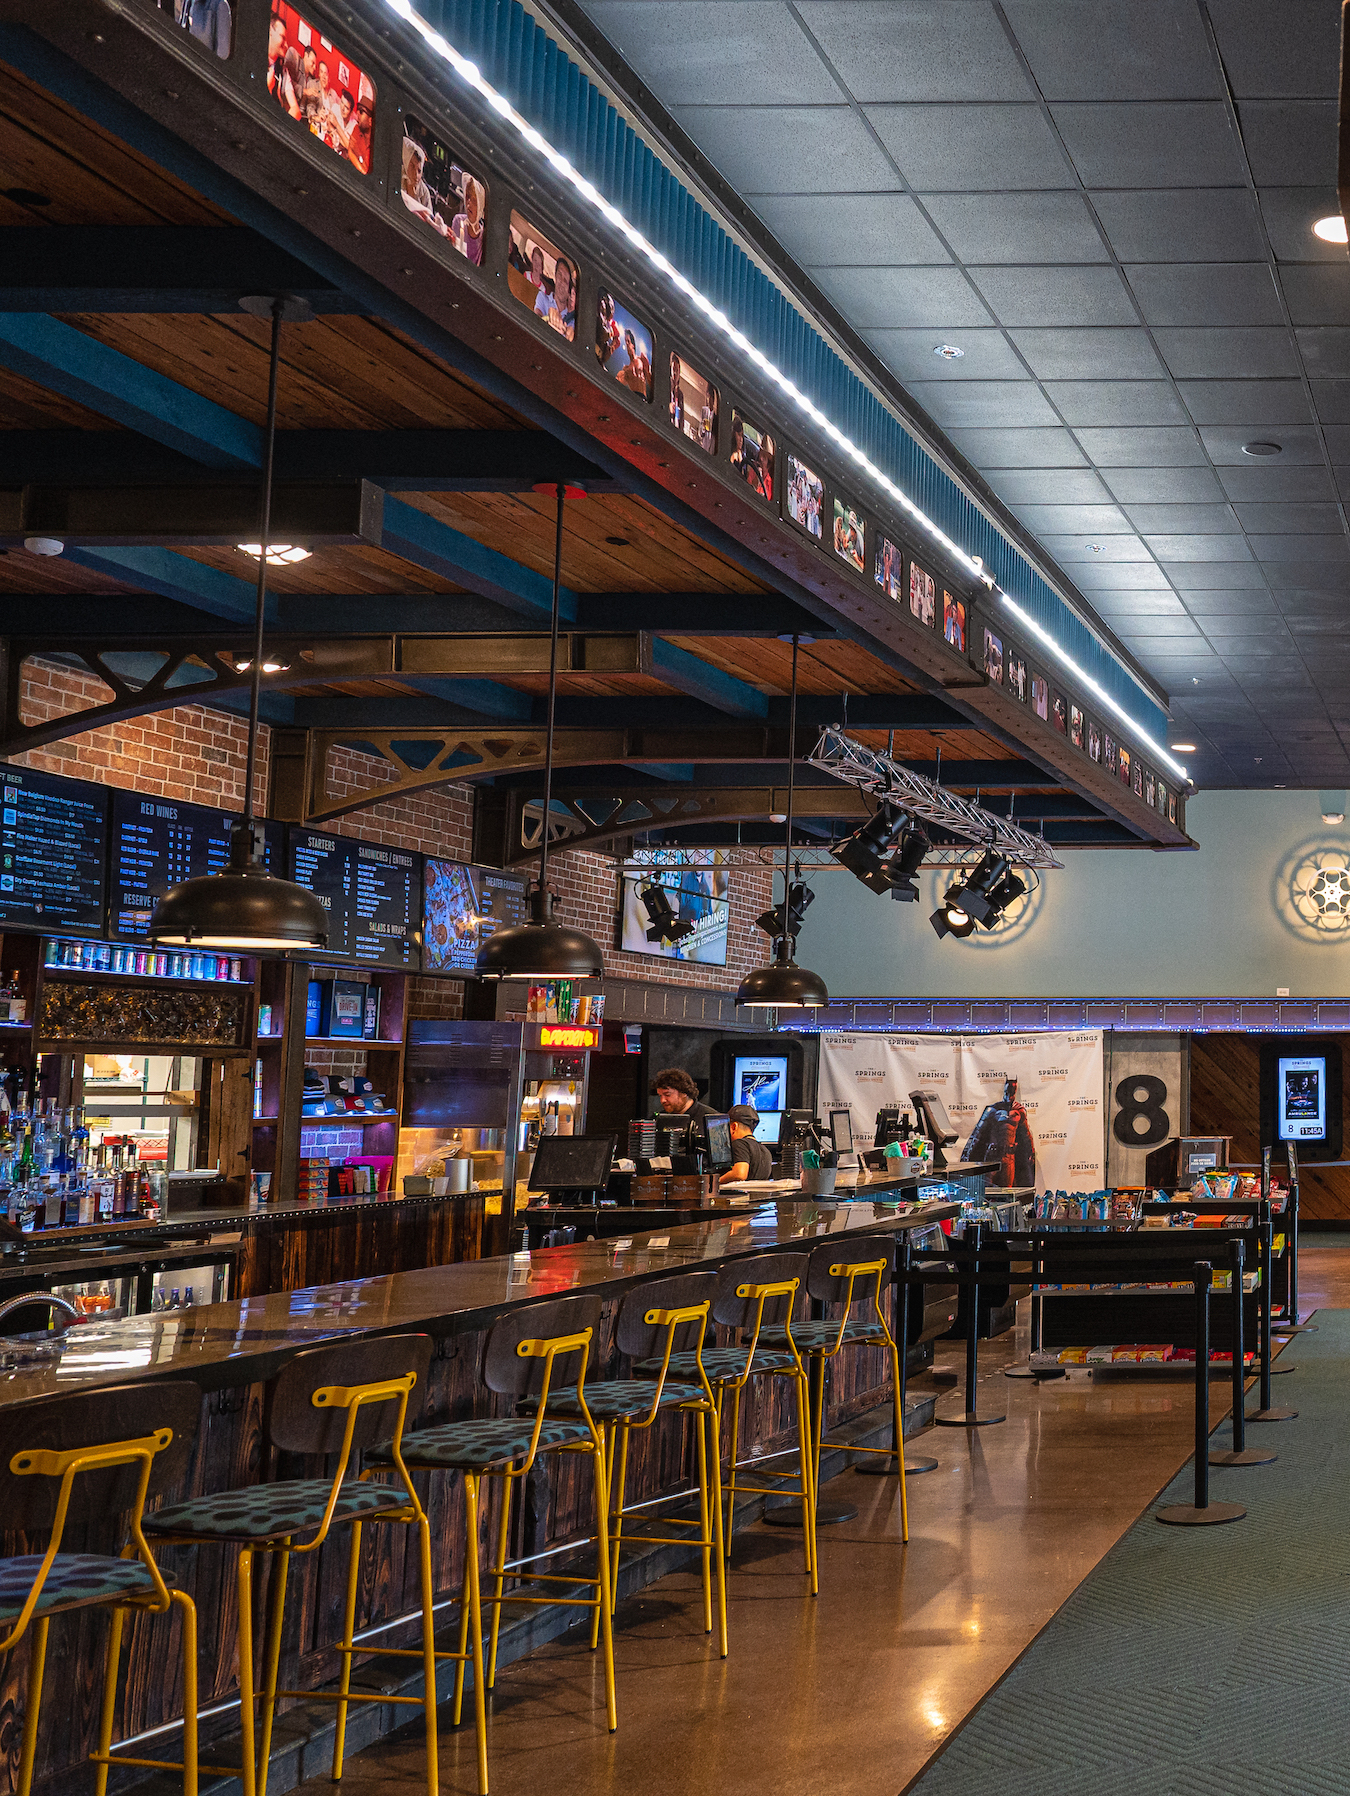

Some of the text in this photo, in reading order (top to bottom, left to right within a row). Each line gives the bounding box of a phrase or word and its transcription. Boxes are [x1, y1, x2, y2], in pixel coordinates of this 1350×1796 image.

[140, 802, 178, 820] RED WINES
[308, 836, 335, 851] STARTERS
[358, 847, 388, 862] SANDWICHES
[392, 855, 413, 867] ENTREES
[123, 893, 151, 907] RESERVE
[700, 908, 727, 930] HIRING!
[369, 922, 386, 933] SALADS
[391, 924, 406, 935] WRAPS
[454, 939, 475, 950] PIZZA
[1114, 1074, 1169, 1144] 8
[1288, 1125, 1294, 1133] 8
